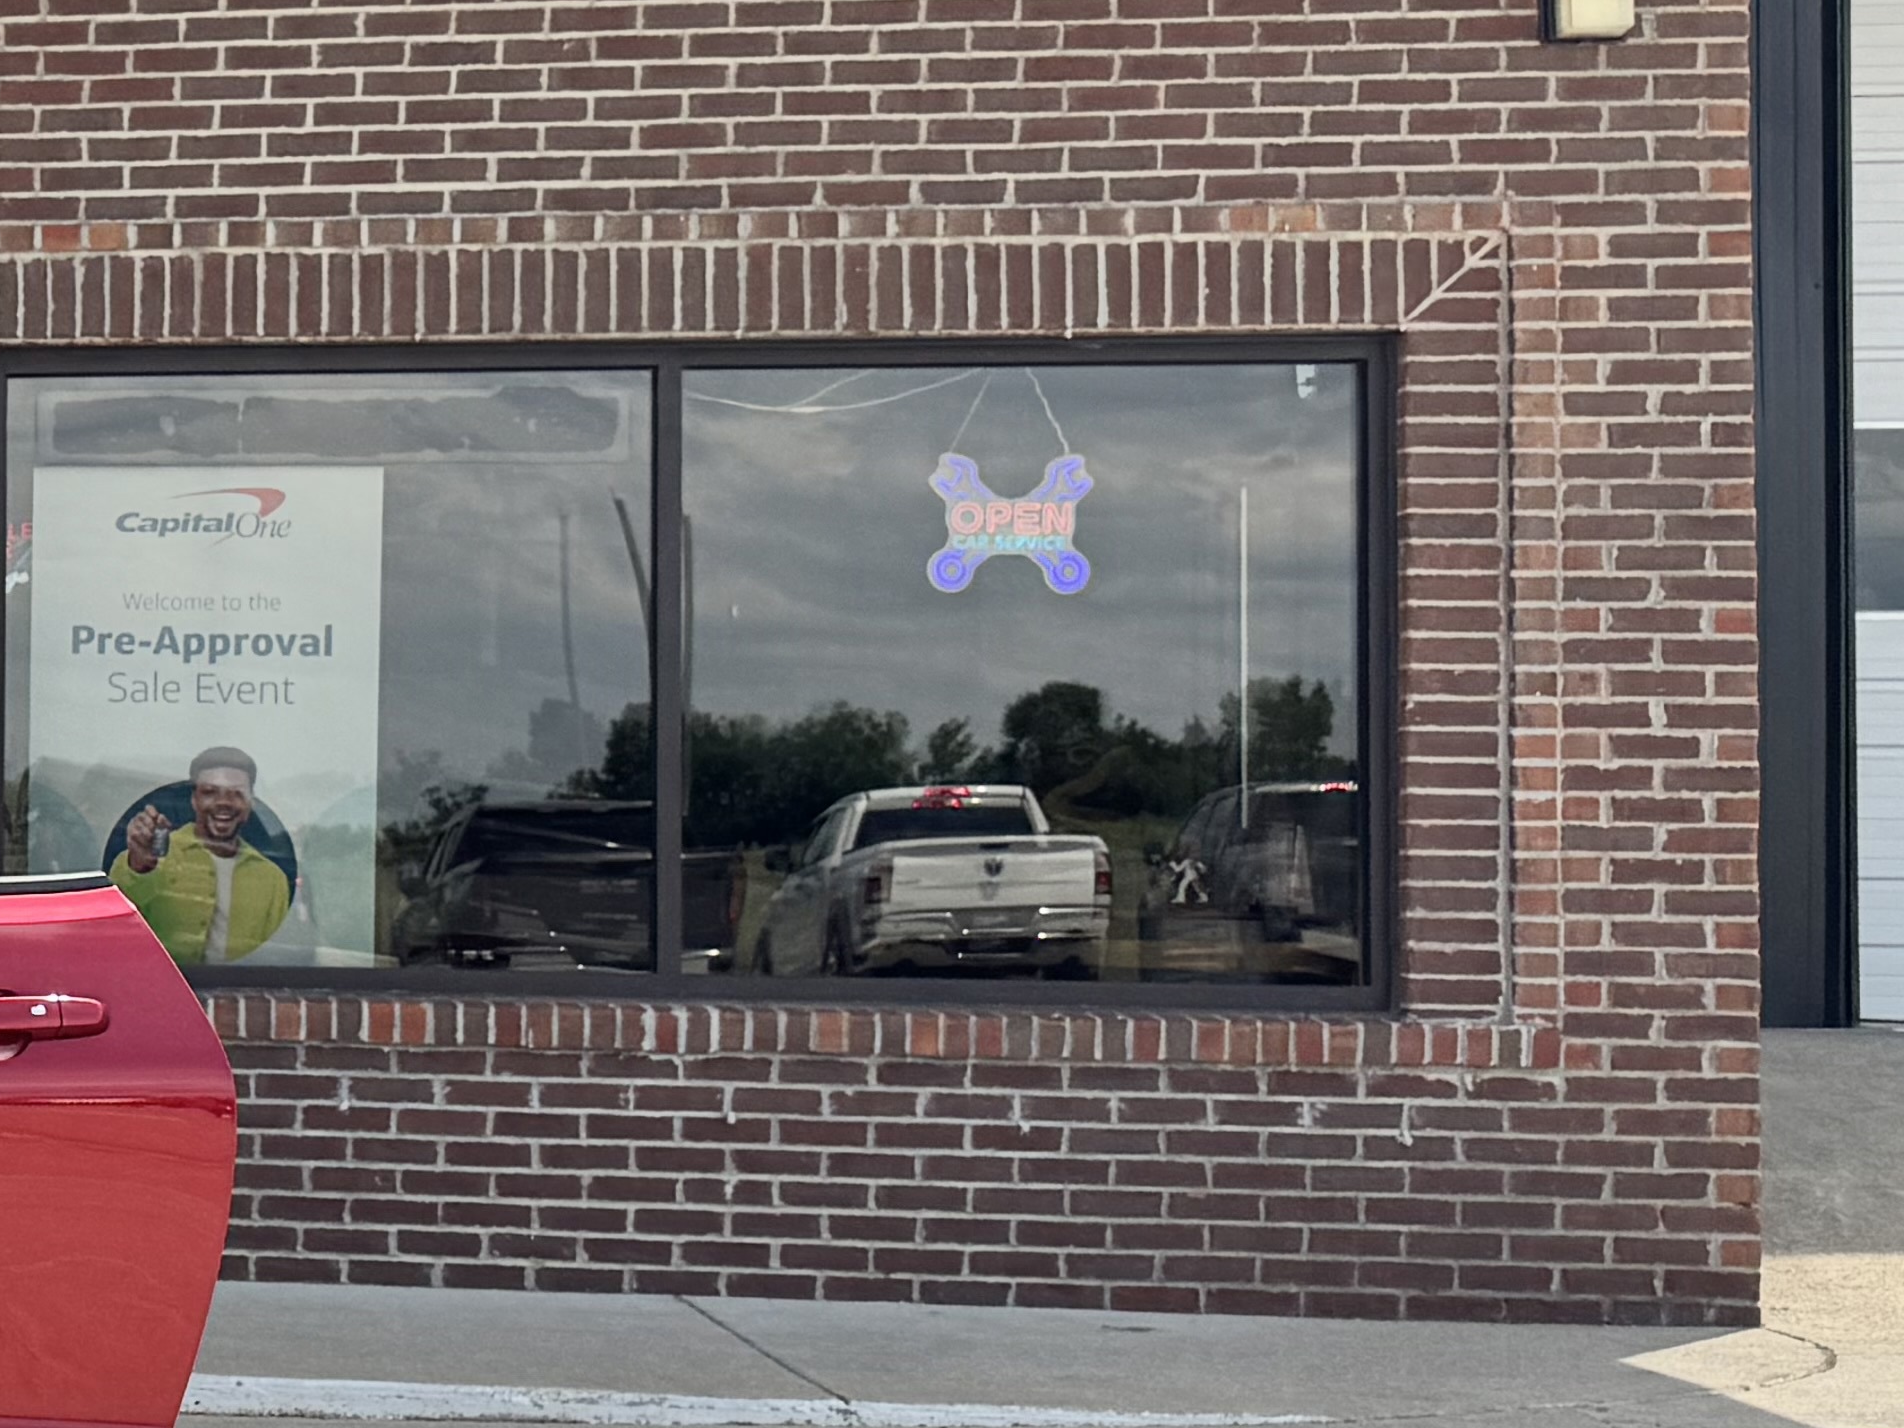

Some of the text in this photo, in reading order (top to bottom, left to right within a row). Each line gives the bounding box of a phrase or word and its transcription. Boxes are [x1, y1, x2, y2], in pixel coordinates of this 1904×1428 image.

[951, 501, 1074, 534] OPEN
[994, 535, 1066, 550] SERVICE
[122, 592, 281, 611] Welcome to the
[71, 624, 333, 664] Pre-Approval
[107, 670, 295, 705] Sale Event
